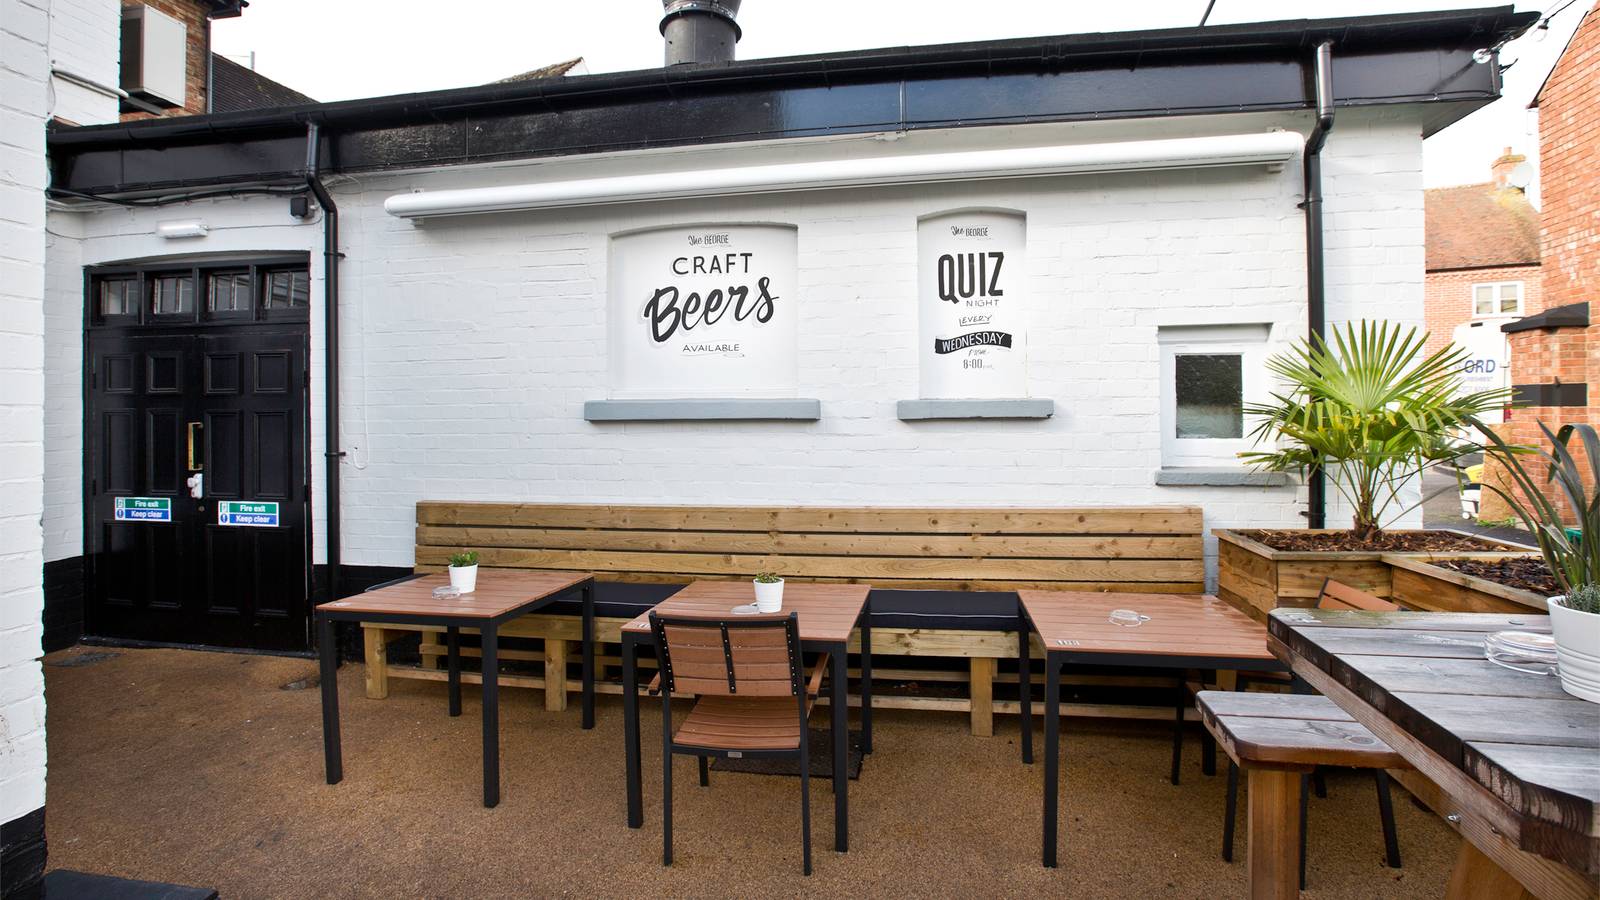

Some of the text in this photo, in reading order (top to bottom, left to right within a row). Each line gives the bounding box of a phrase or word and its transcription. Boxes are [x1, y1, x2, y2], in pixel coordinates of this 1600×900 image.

[965, 227, 989, 237] GEORGE
[704, 234, 729, 245] GEORGE
[672, 252, 753, 275] CRAFT
[938, 251, 1004, 304] QUIZ
[966, 299, 1000, 307] NIGHT
[643, 276, 780, 342] Beers
[682, 343, 740, 352] AVAILABLE
[942, 333, 1005, 352] WEDNESDAY
[239, 504, 253, 512] Fire
[131, 510, 163, 518] Keep clear
[235, 514, 271, 524] Keep clear
